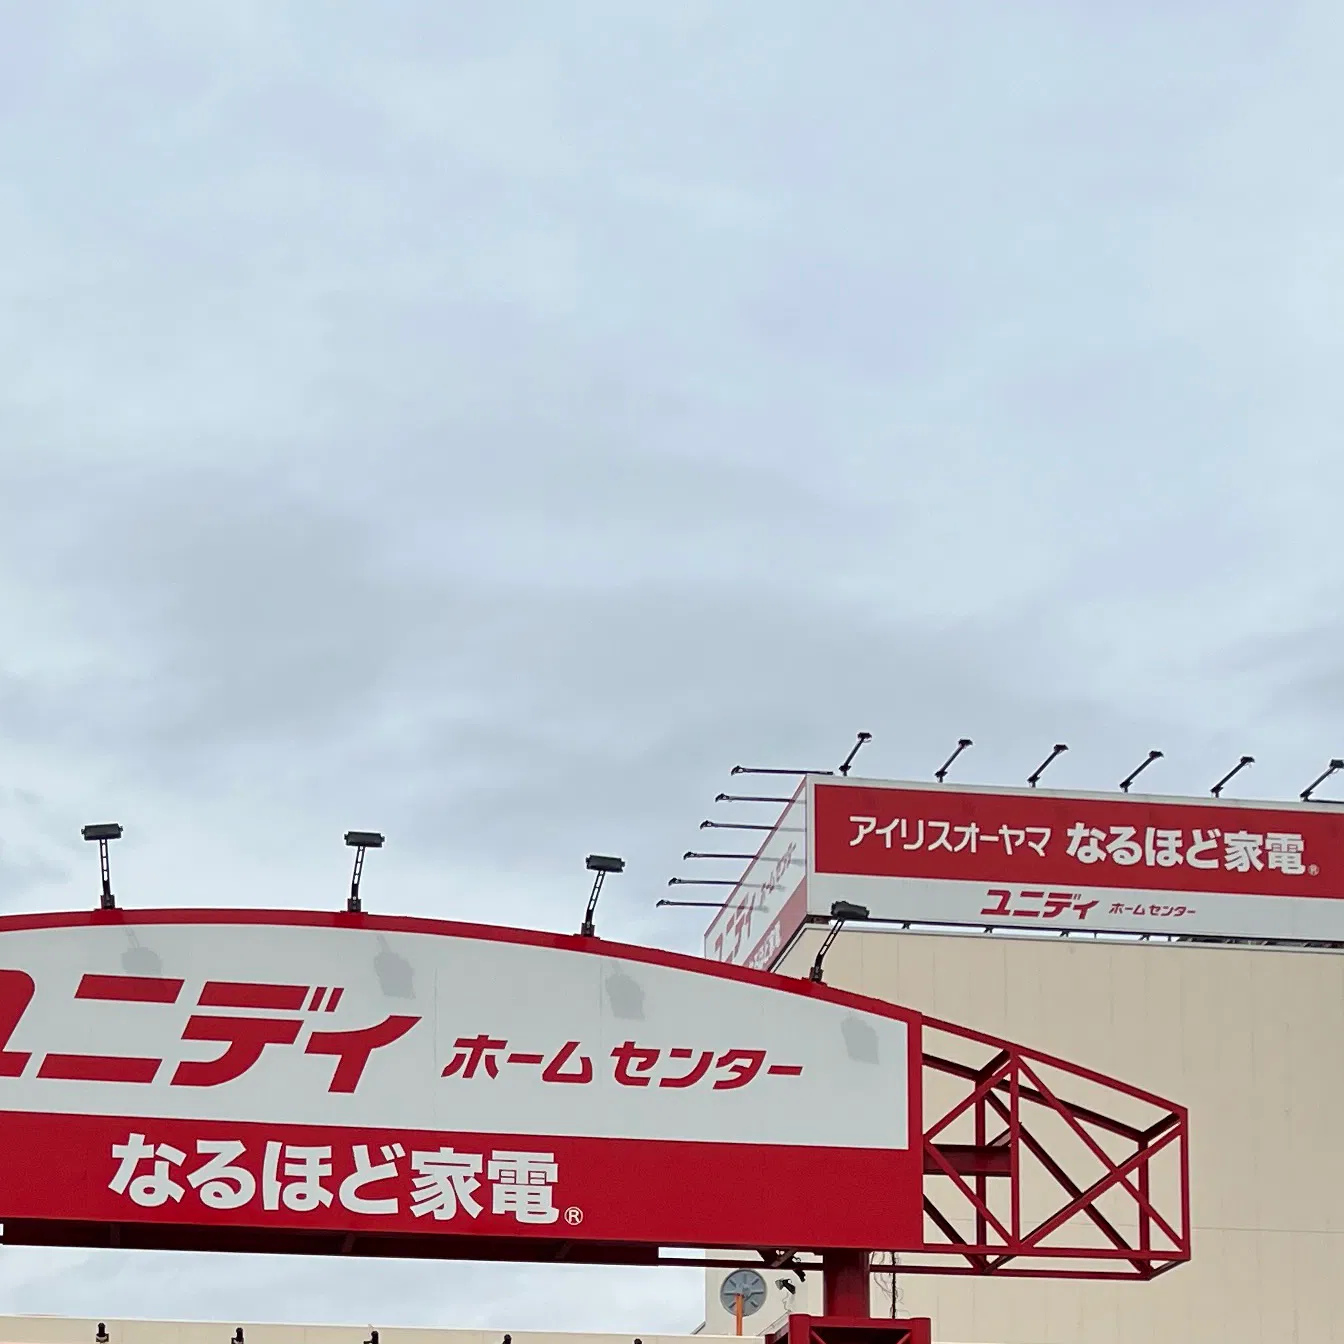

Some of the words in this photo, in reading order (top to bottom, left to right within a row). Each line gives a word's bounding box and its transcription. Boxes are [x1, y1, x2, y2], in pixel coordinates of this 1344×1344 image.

[849, 816, 1053, 857] アイリスオーヤマ
[981, 889, 1100, 920] ユニディ
